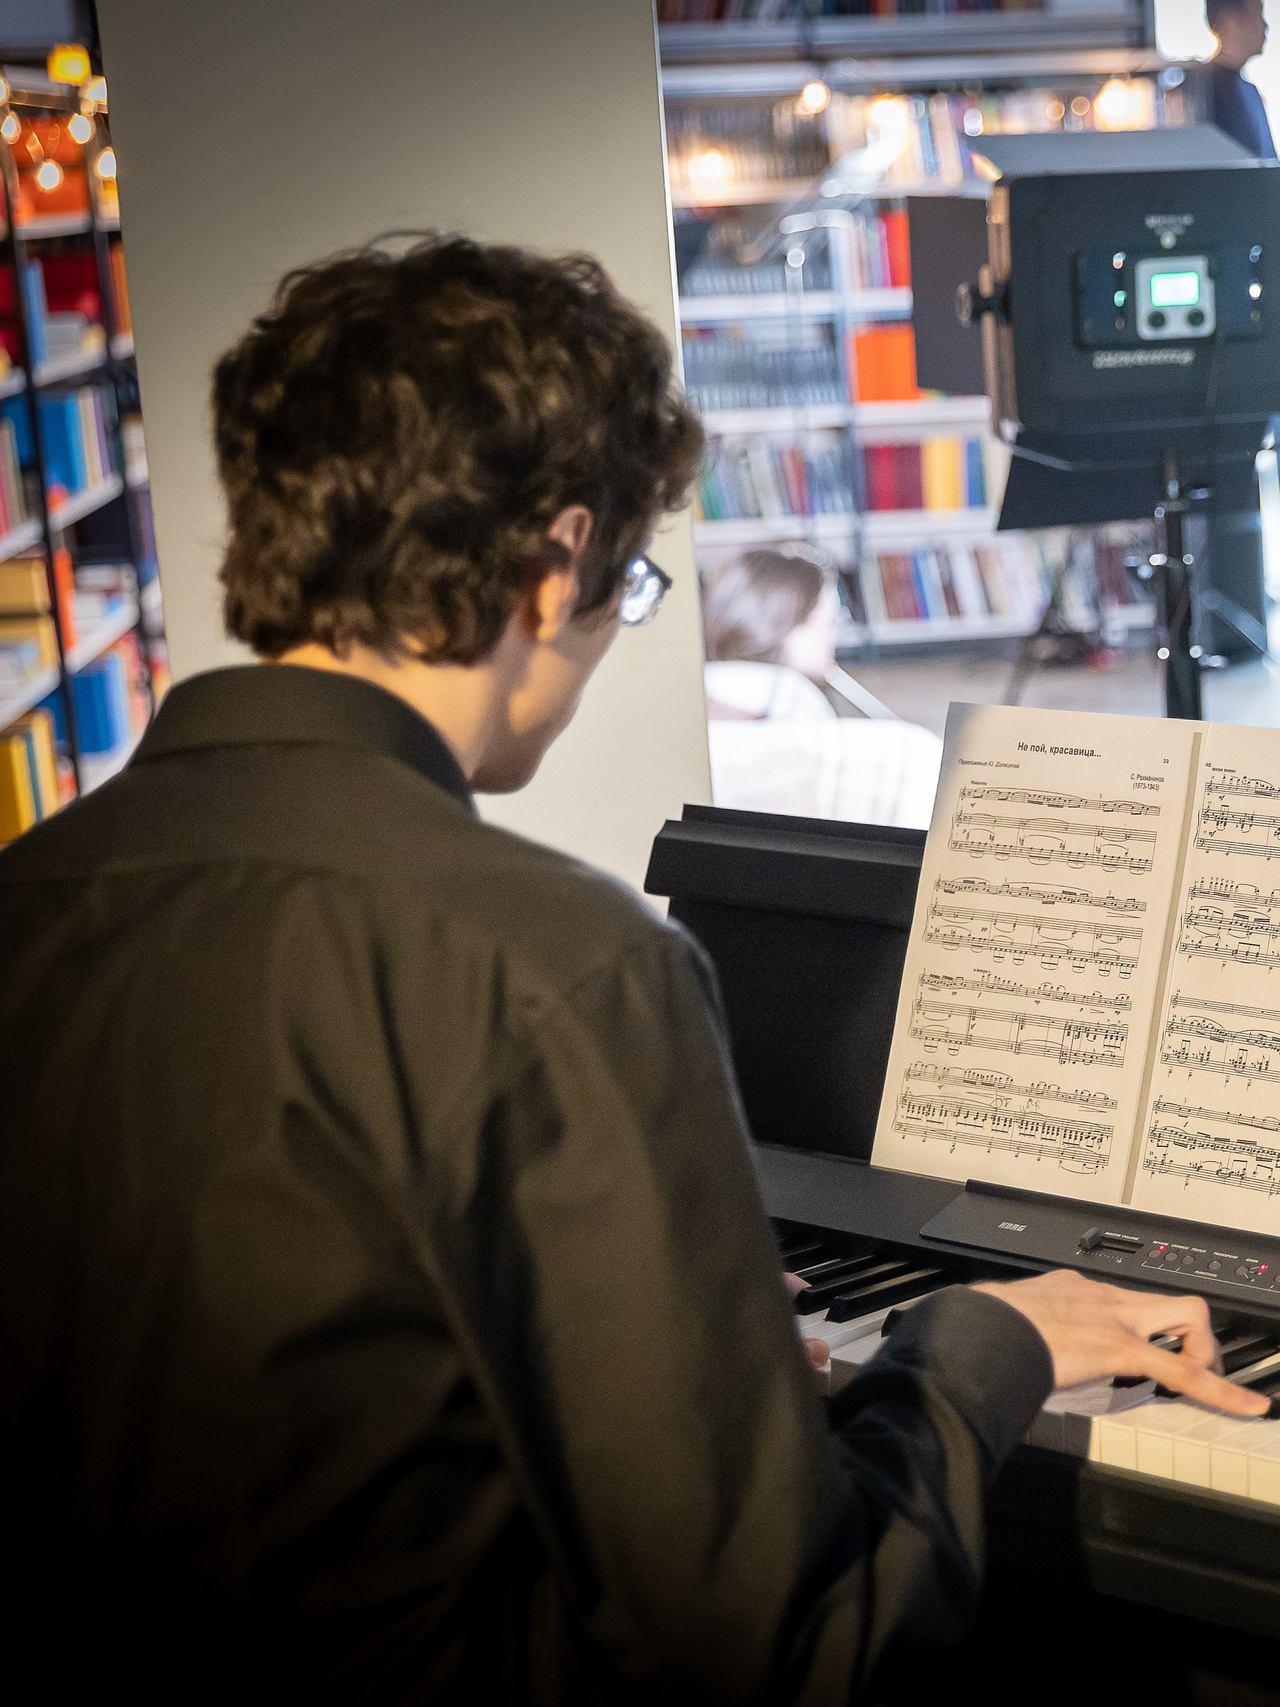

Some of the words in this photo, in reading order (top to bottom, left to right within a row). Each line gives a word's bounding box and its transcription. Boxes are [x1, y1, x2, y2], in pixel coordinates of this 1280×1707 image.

[1017, 741, 1028, 753] Не
[1030, 743, 1048, 755] пой,
[1050, 744, 1102, 758] красавица...
[1136, 773, 1165, 783] Рахманинов
[998, 1221, 1027, 1232] KORG
